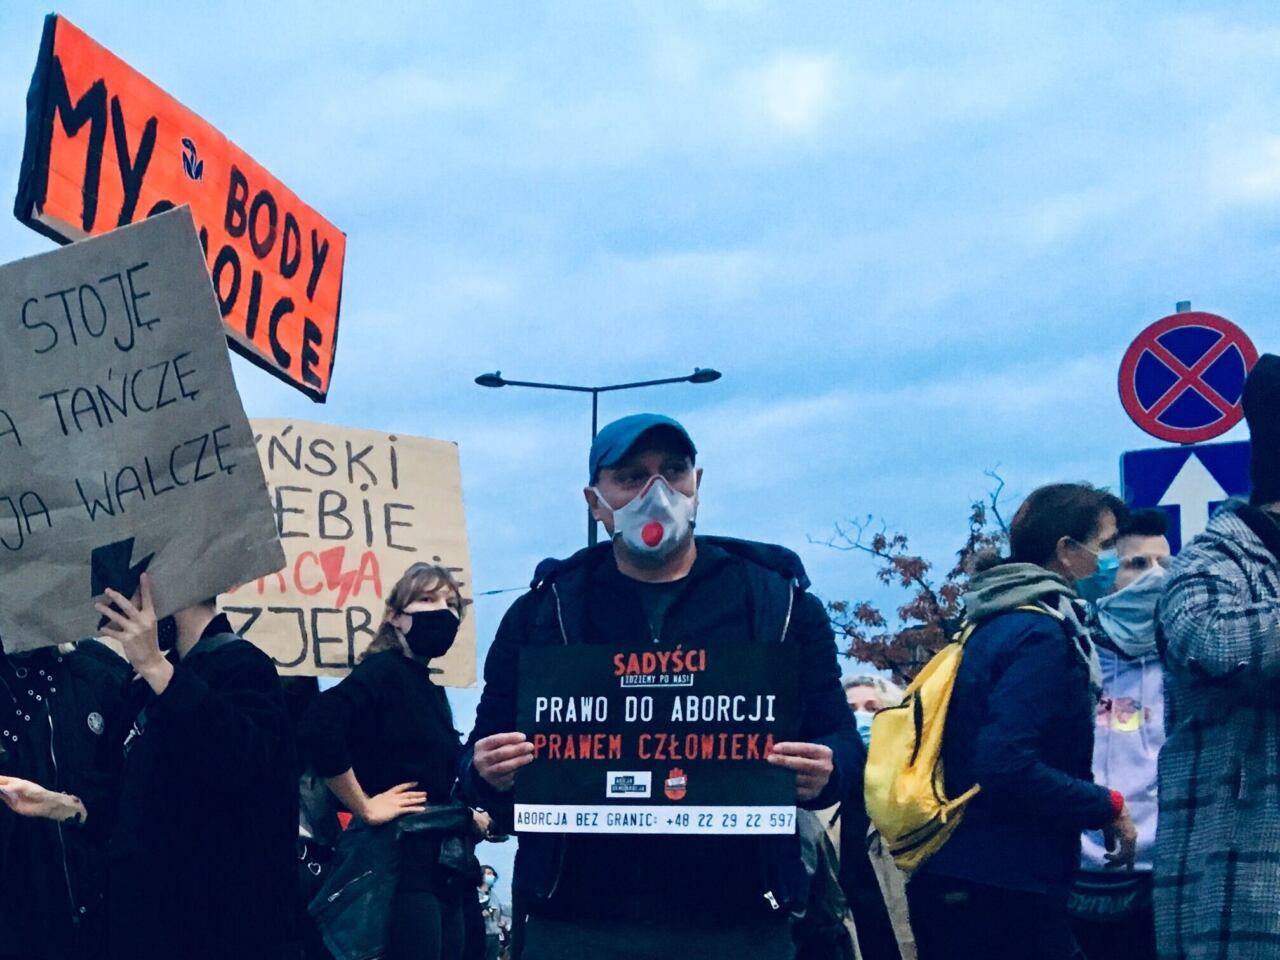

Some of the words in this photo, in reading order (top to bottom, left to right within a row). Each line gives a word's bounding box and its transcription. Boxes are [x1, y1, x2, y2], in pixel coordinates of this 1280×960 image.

[225, 164, 329, 301] BODY
[21, 262, 161, 354] STOJĘ
[39, 351, 201, 437] TAŃCZĘ
[613, 643, 706, 676] SADYŚCI
[535, 696, 608, 722] PRAWO
[625, 696, 653, 722] DO
[671, 695, 776, 722] ABORCJI
[533, 733, 622, 760] PRAWEM
[638, 732, 776, 760] CZŁOWIEKA
[517, 812, 568, 825] ABORCJA
[576, 813, 598, 826] BEZ
[666, 813, 689, 827] +48
[698, 814, 713, 827] 22
[722, 814, 737, 827] 29
[746, 814, 761, 827] 22
[770, 814, 793, 827] 597
